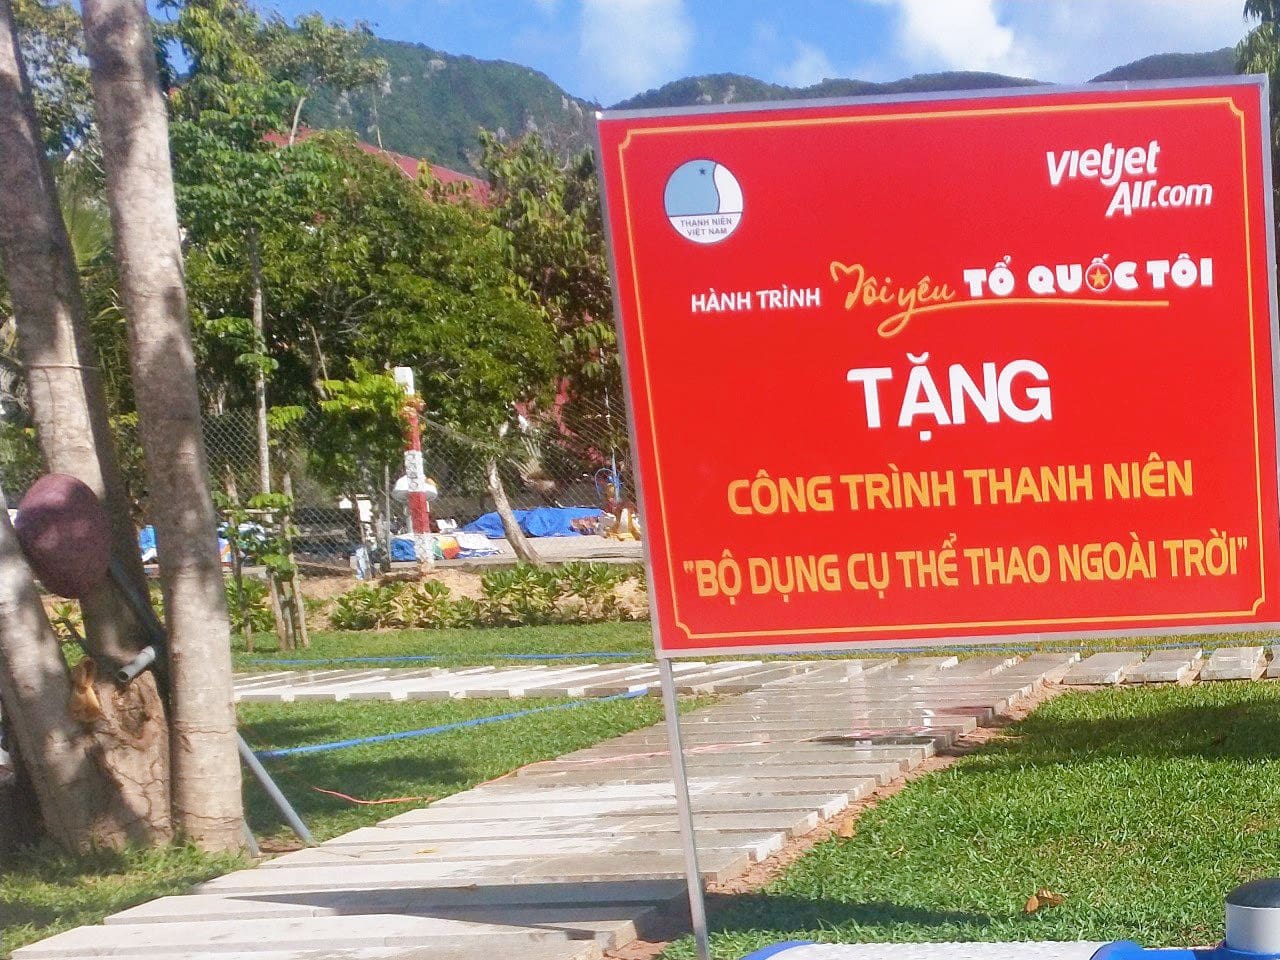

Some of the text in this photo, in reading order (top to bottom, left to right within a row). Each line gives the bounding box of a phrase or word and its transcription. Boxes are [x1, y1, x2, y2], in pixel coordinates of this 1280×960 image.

[680, 217, 732, 227] THANH NIÊN
[709, 227, 728, 235] NAM
[691, 288, 751, 312] HÀNH
[756, 284, 821, 308] TRÌNH
[877, 275, 956, 338] yêu
[963, 255, 1015, 297] TỔ
[1028, 254, 1139, 294] QUỐC
[1147, 253, 1213, 289] TÔI
[847, 352, 1053, 441] TẶNG
[727, 452, 1193, 515] CÔNG TRÌNH THANH NIÊN
[748, 554, 842, 603] DỤNG
[848, 552, 890, 599] CỤ
[895, 533, 959, 588] THỂ
[964, 545, 1050, 586] THAO
[1058, 532, 1157, 582] NGOÀI
